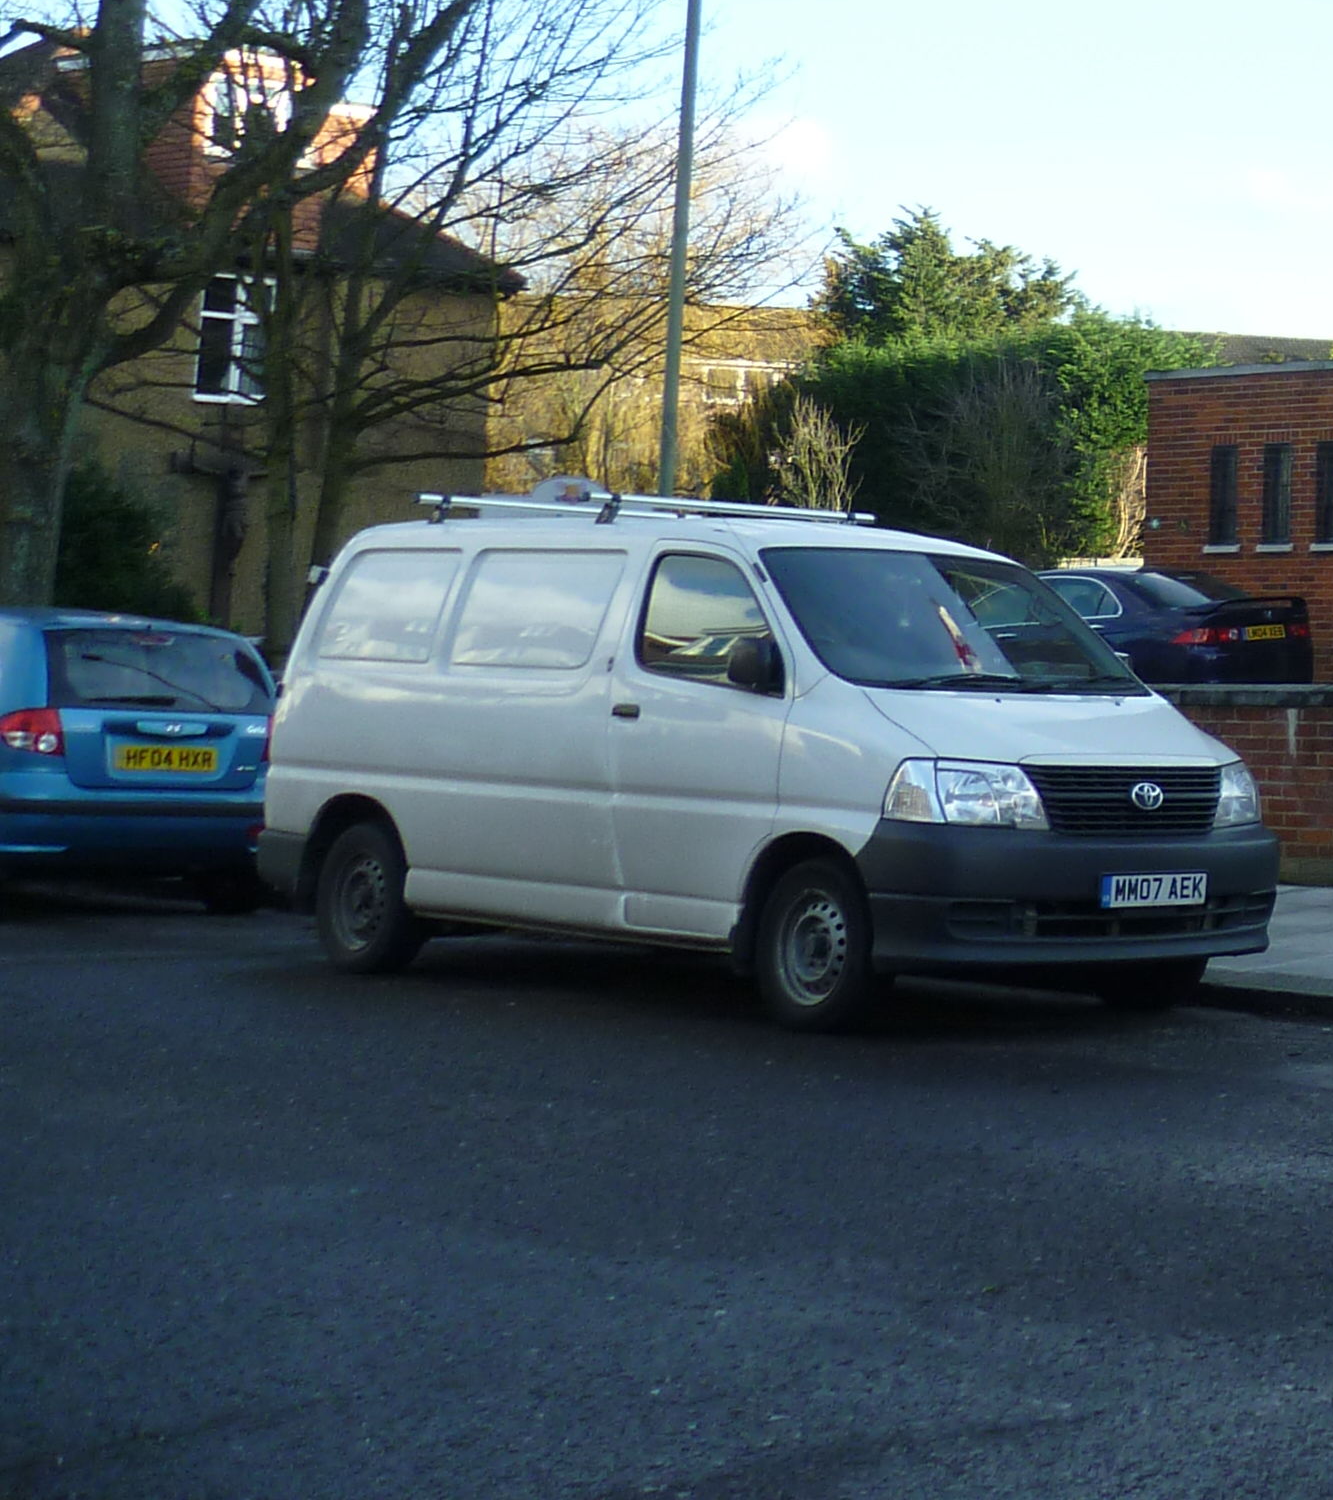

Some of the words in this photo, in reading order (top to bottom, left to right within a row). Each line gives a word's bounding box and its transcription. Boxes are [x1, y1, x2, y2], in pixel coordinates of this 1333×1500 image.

[125, 748, 173, 767] HF04
[1115, 877, 1163, 902] MM07
[1168, 875, 1204, 900] AEK
